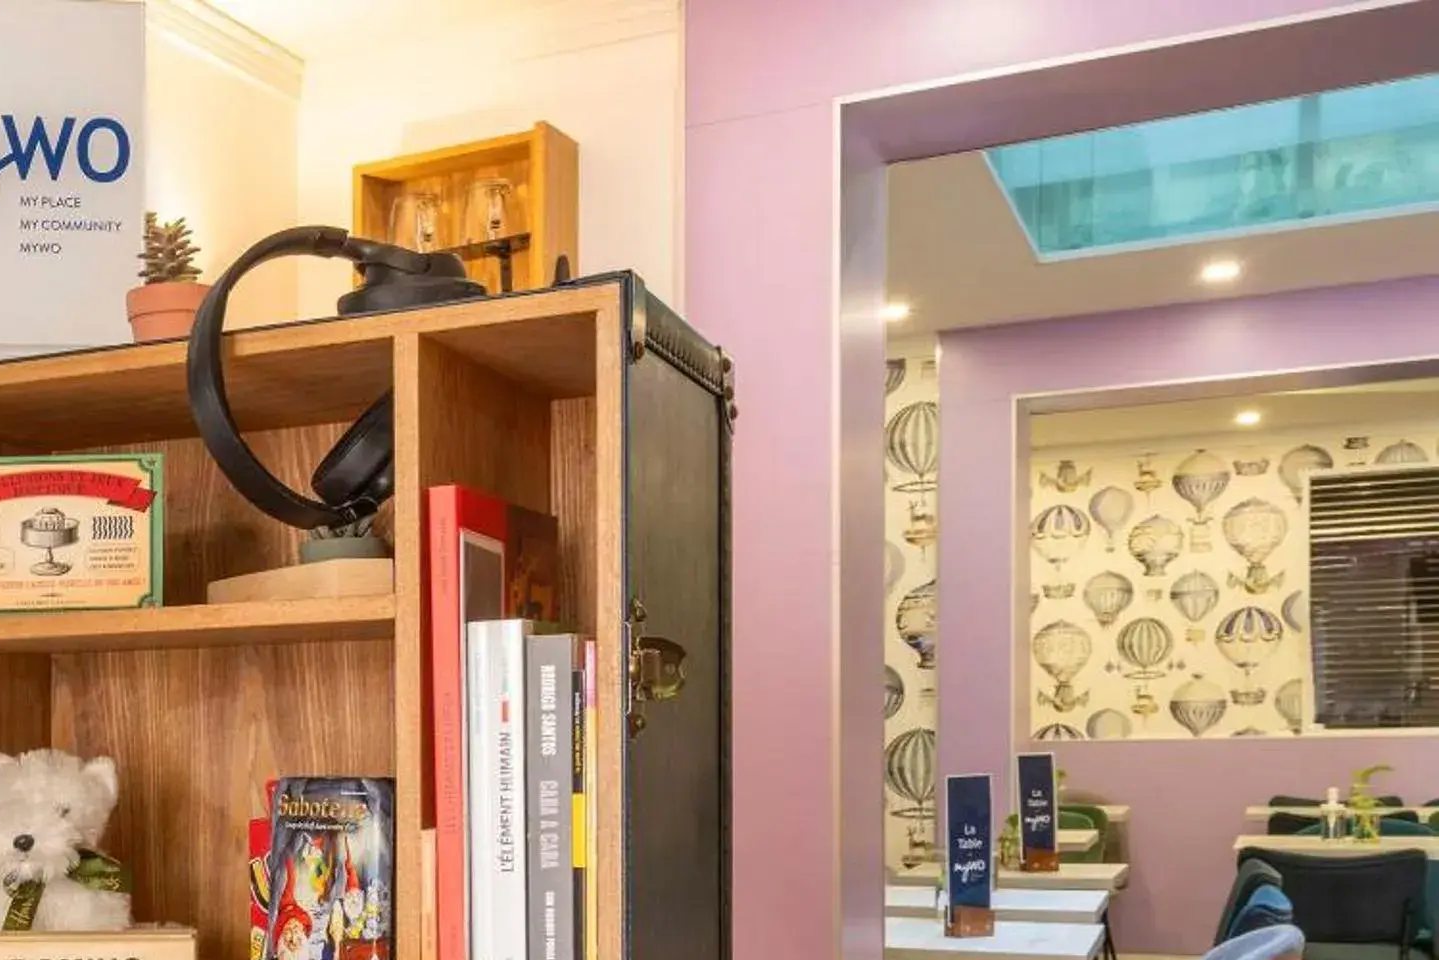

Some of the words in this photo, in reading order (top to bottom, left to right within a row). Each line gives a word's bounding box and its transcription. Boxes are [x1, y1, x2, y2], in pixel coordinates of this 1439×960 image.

[19, 197, 39, 208] MY
[41, 196, 82, 208] PLACE
[19, 219, 39, 231] MY
[41, 219, 122, 232] COMMUNITY
[19, 242, 62, 254] MYWO
